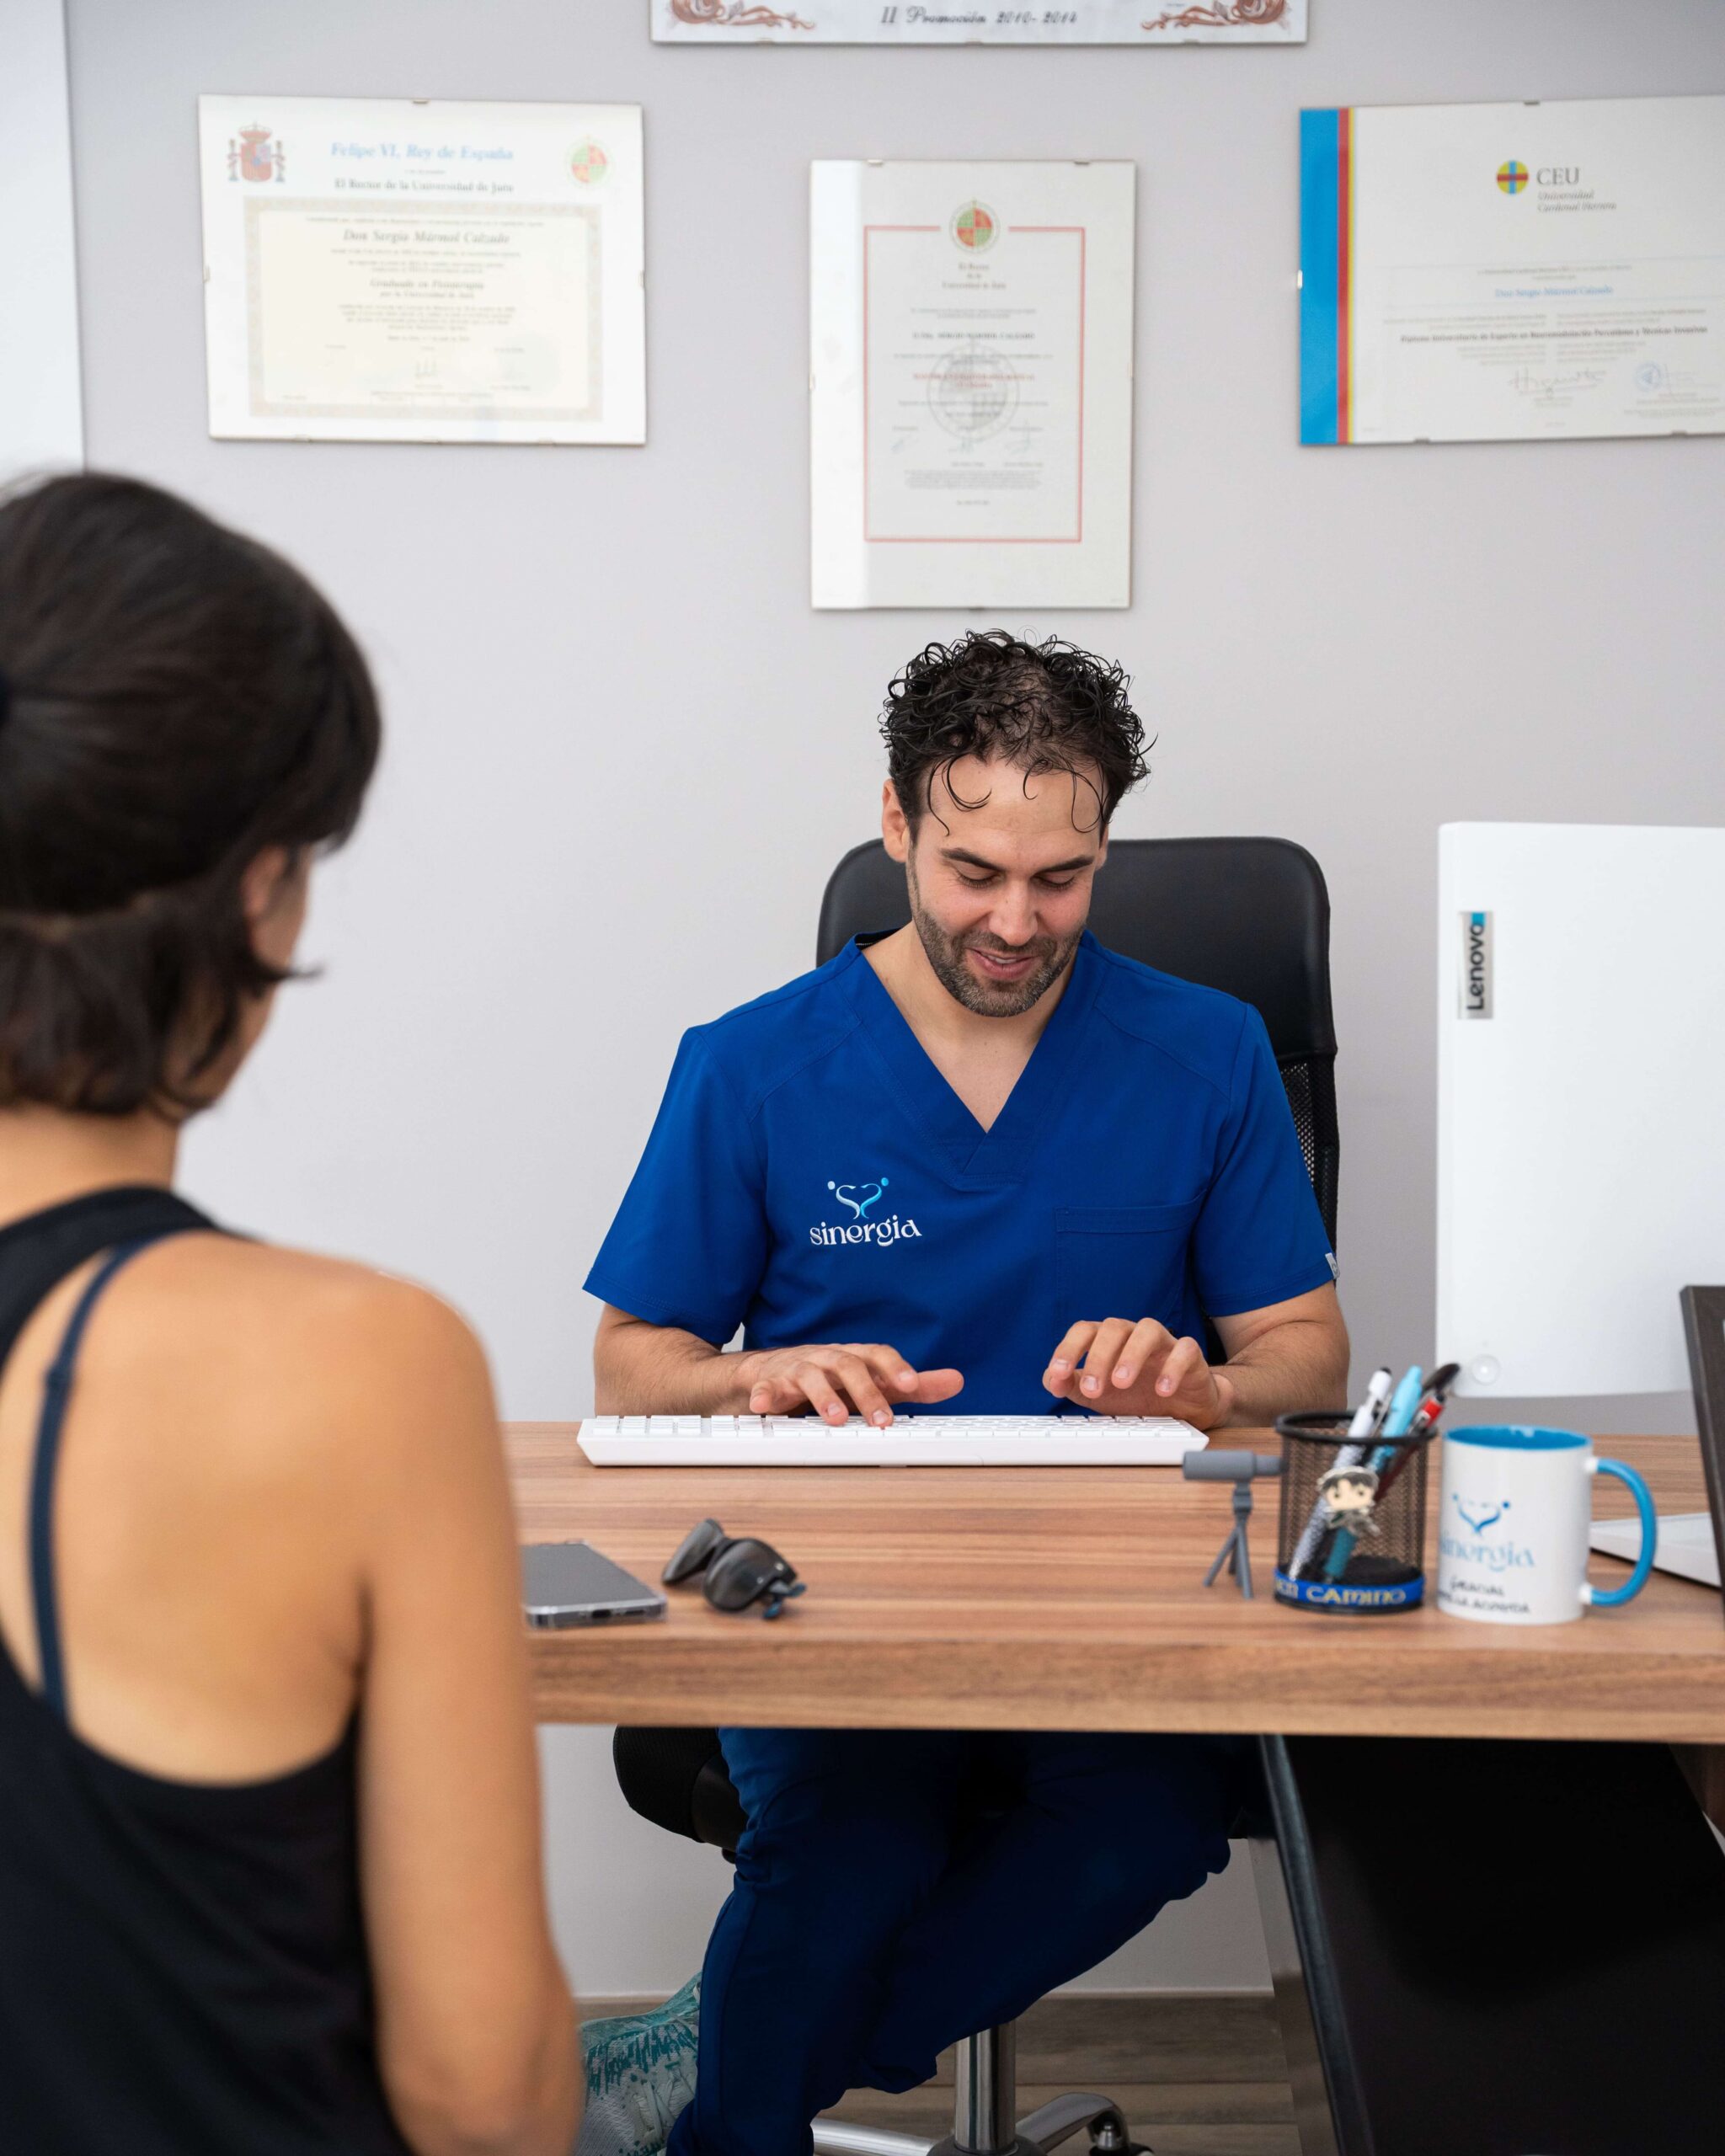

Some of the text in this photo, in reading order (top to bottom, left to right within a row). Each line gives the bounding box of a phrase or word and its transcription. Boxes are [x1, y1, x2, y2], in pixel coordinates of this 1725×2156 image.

[881, 6, 897, 24] II
[905, 6, 986, 24] Promoción
[330, 142, 376, 160] Felipe
[406, 143, 431, 161] Rey
[437, 144, 456, 158] de
[460, 146, 513, 161] España
[1536, 167, 1580, 185] CEU
[343, 229, 369, 241] Don
[371, 229, 409, 243] Sergio
[1466, 923, 1484, 1010] Lenovo
[809, 1214, 922, 1246] sinergia
